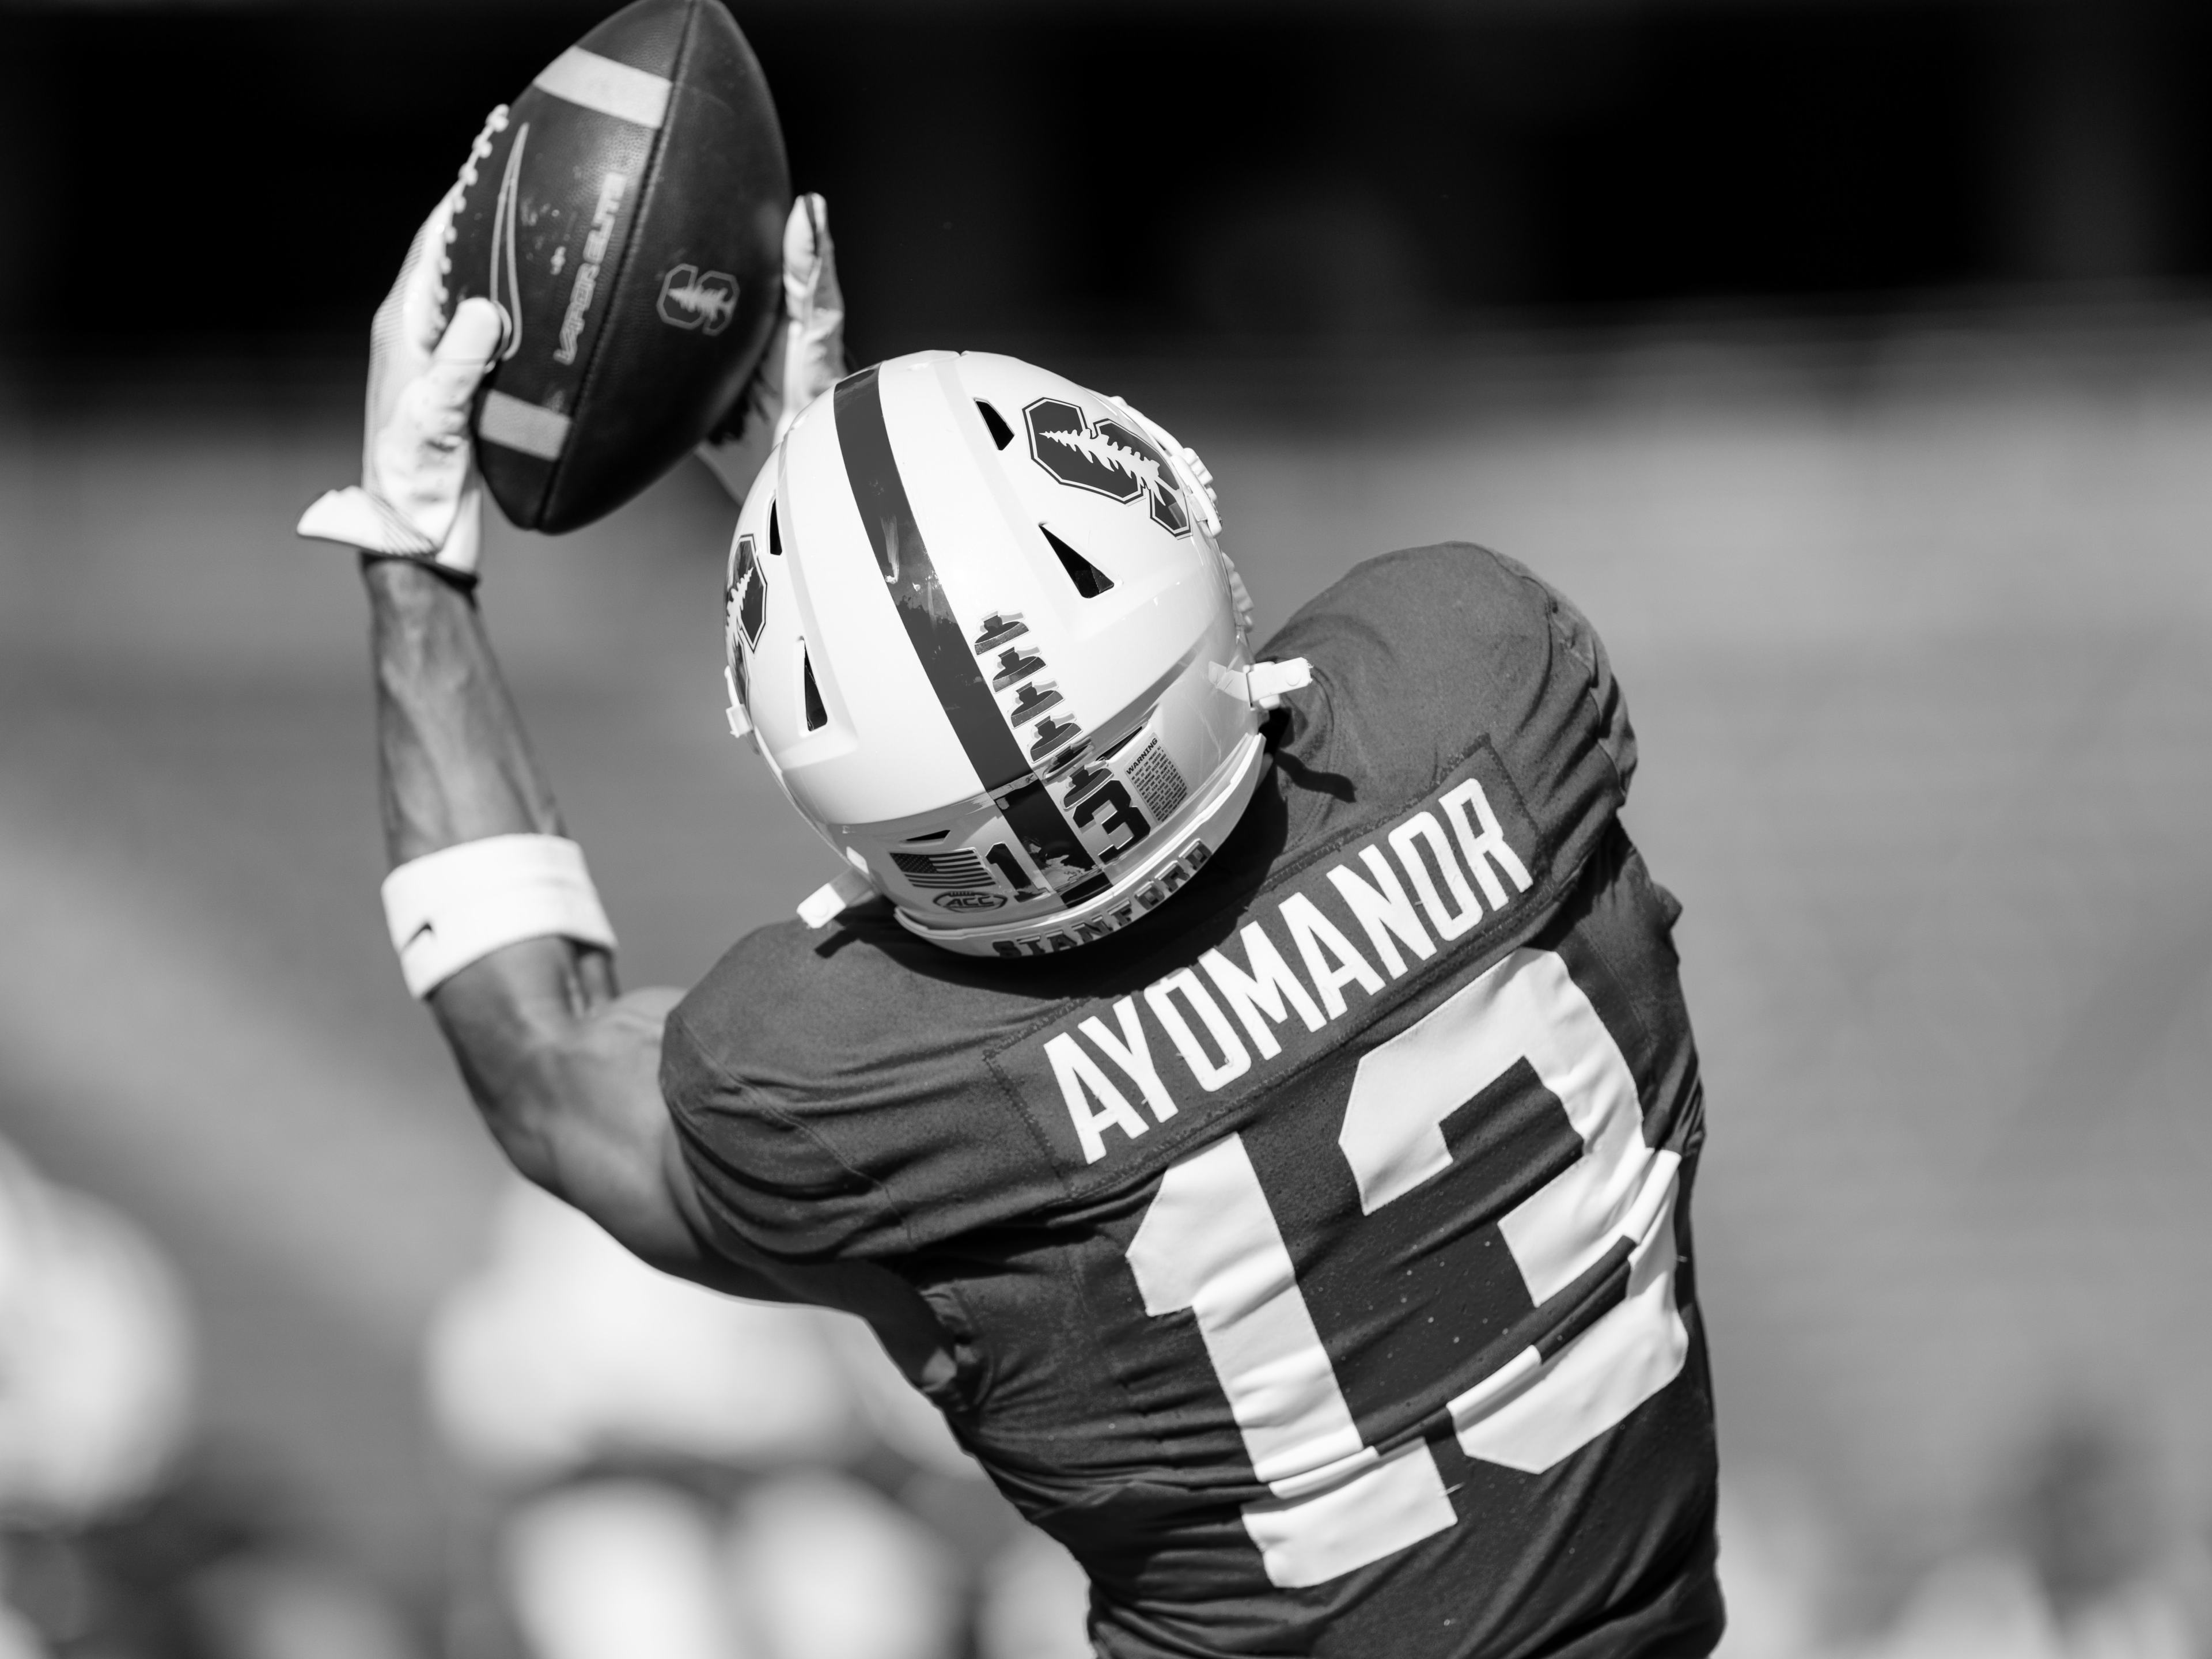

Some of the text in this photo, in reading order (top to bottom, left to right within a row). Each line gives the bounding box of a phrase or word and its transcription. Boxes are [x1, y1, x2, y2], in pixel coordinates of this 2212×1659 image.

[1126, 737, 1158, 775] WARNING
[946, 895, 995, 908] ACC
[992, 838, 1212, 958] STANFORD
[1043, 777, 1533, 1164] AYOMANOR
[1124, 948, 1688, 1589] 13
